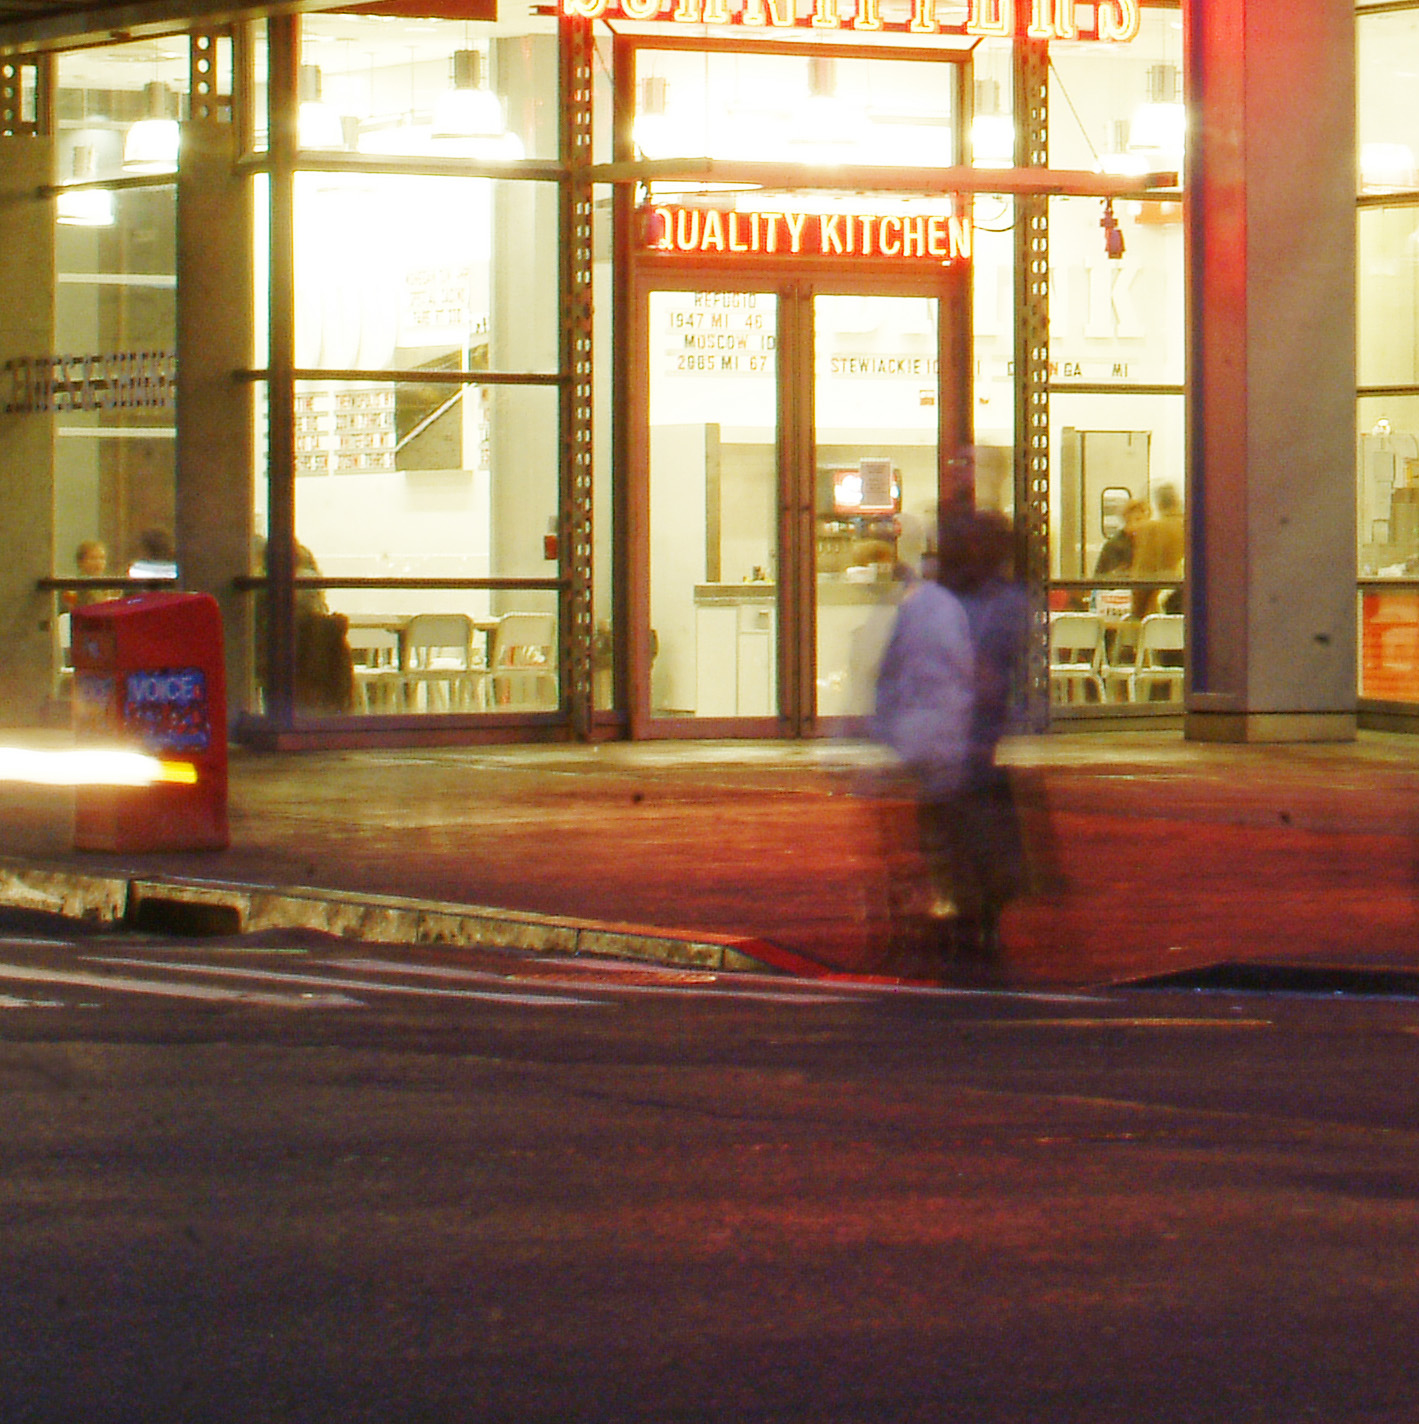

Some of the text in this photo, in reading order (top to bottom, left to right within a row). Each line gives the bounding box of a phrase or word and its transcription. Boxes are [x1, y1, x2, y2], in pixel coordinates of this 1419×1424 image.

[655, 208, 972, 259] QUALITY KITCHEN
[670, 312, 704, 329] 1947
[684, 334, 748, 350] MOSCOW
[127, 675, 196, 702] VOICE
